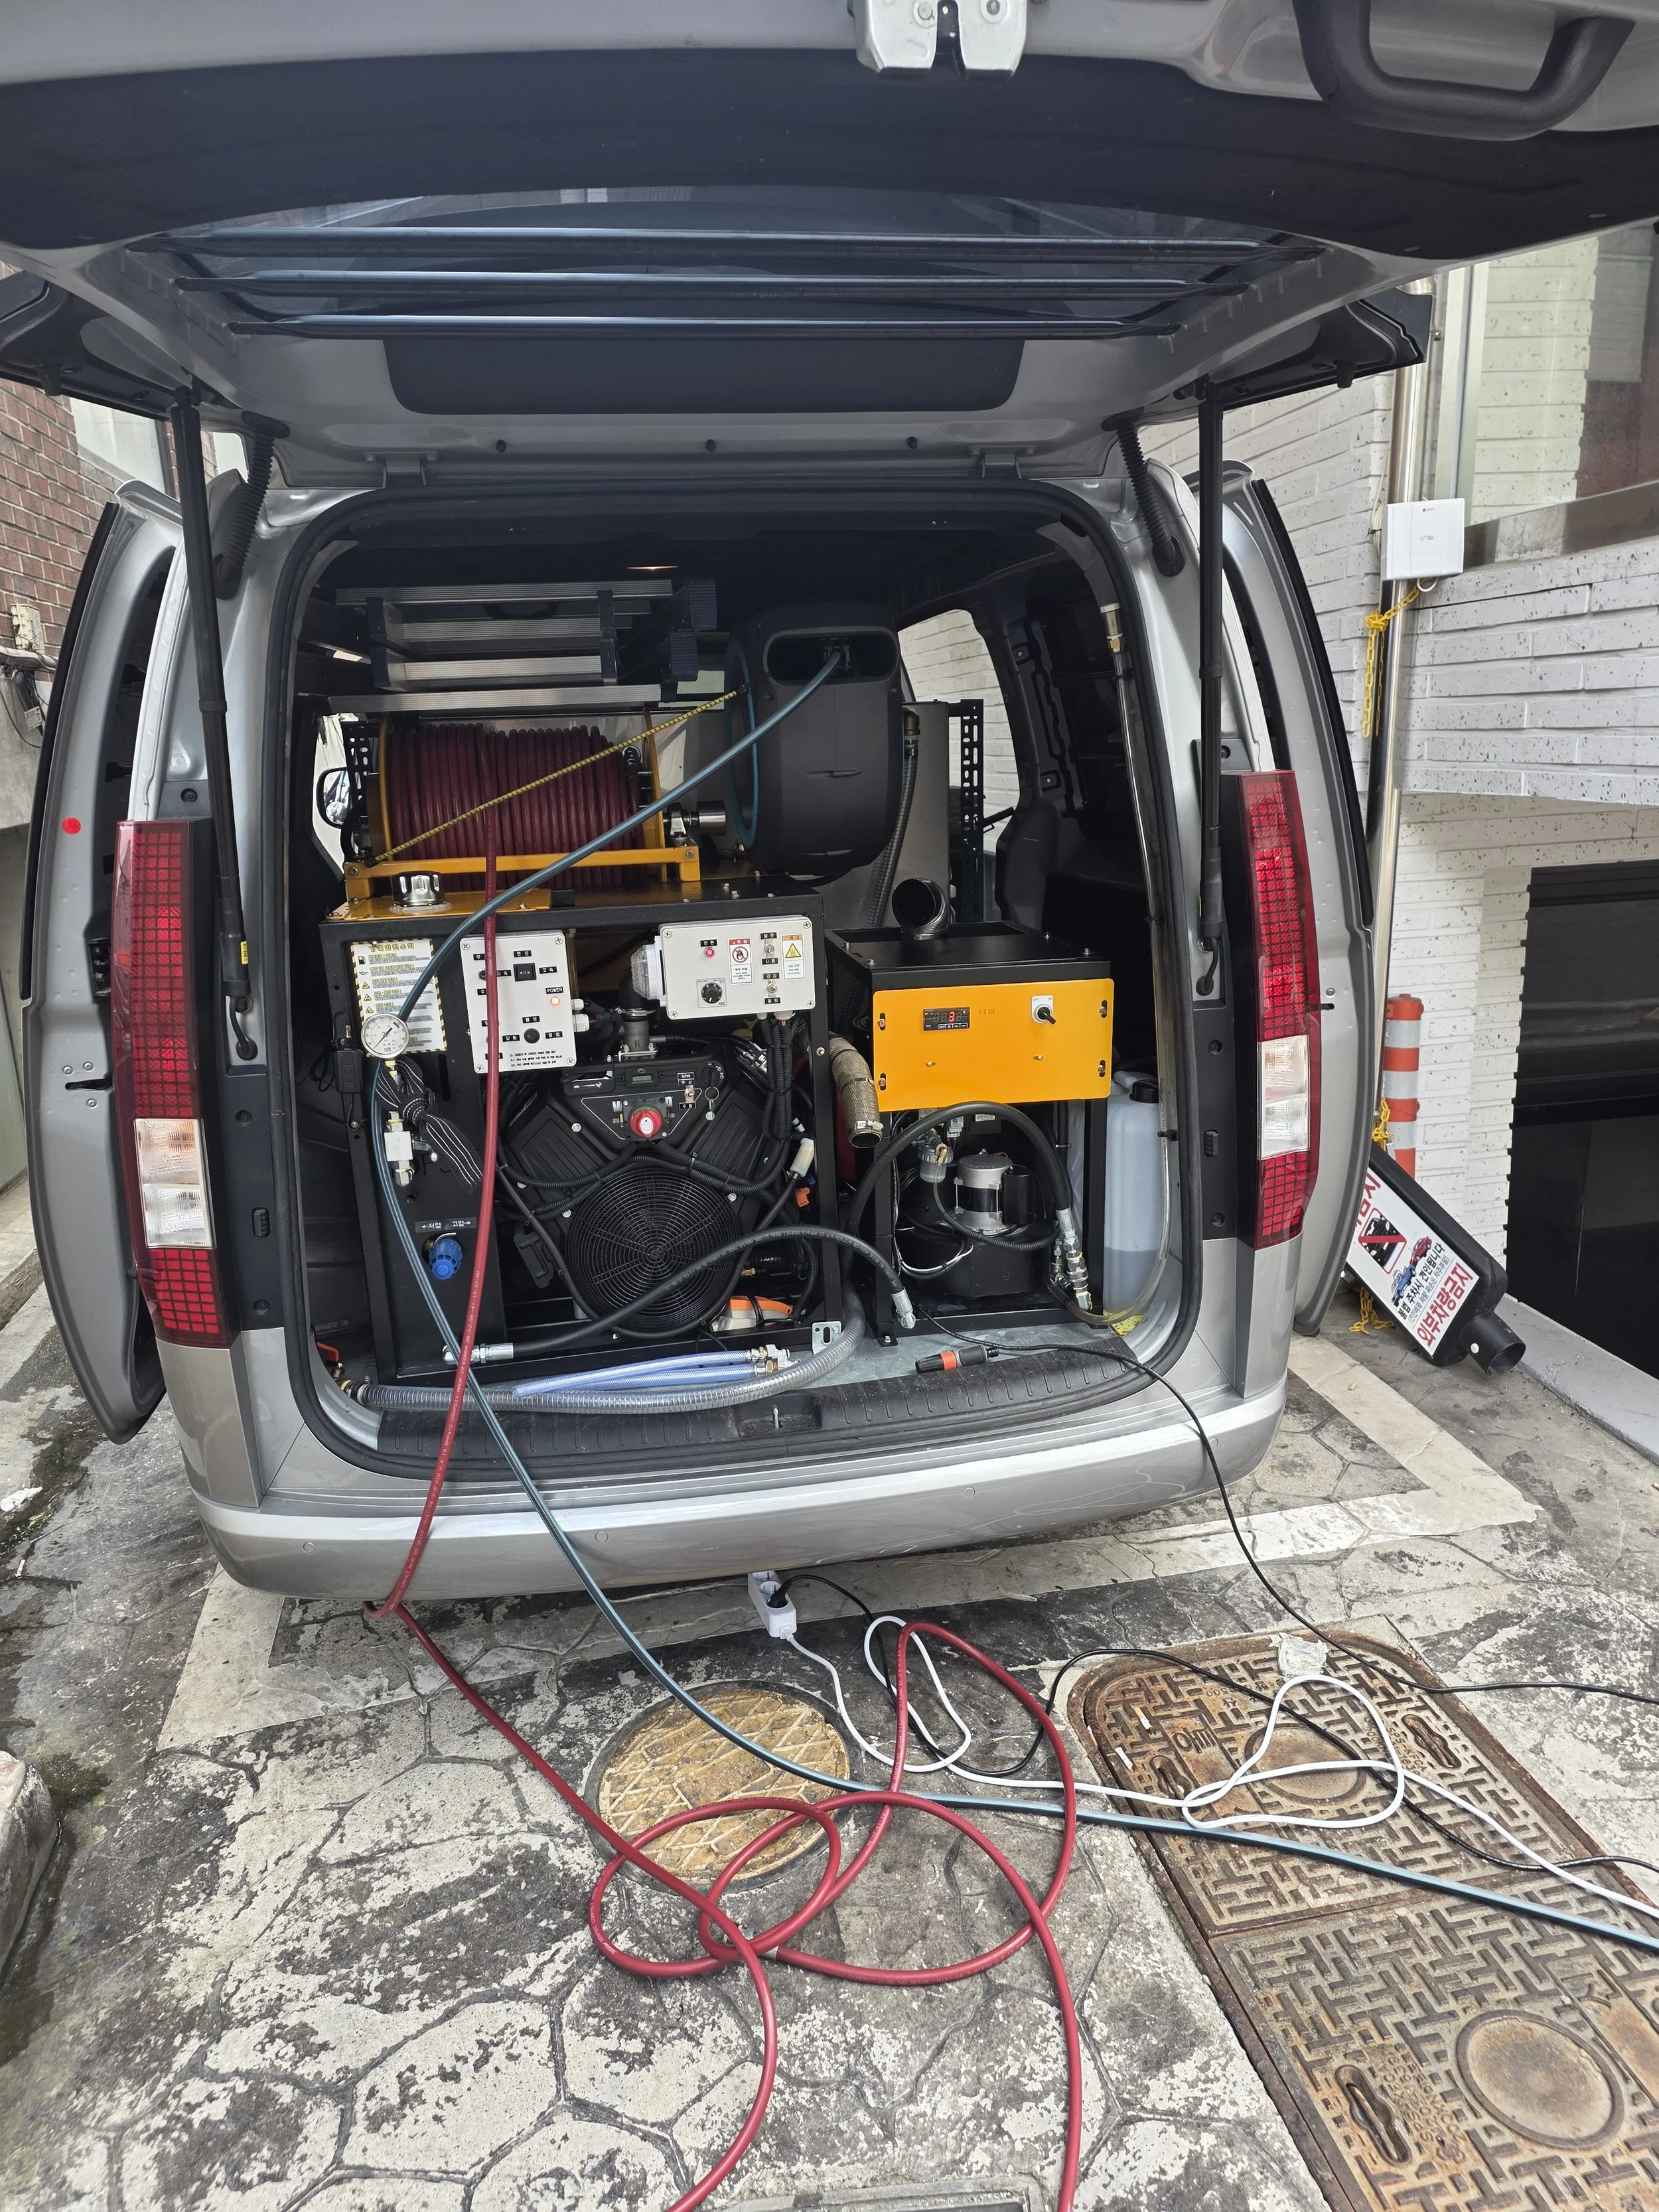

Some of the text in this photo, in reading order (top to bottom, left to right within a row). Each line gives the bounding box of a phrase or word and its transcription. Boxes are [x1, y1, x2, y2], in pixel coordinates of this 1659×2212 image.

[948, 1010, 956, 1023] 3
[427, 1219, 465, 1230] 저압 고압
[1398, 1242, 1446, 1321] 불법 주차시 견인됩니다
[1425, 1277, 1437, 1295] 파손은
[1416, 1262, 1474, 1347] 외부차량금지
